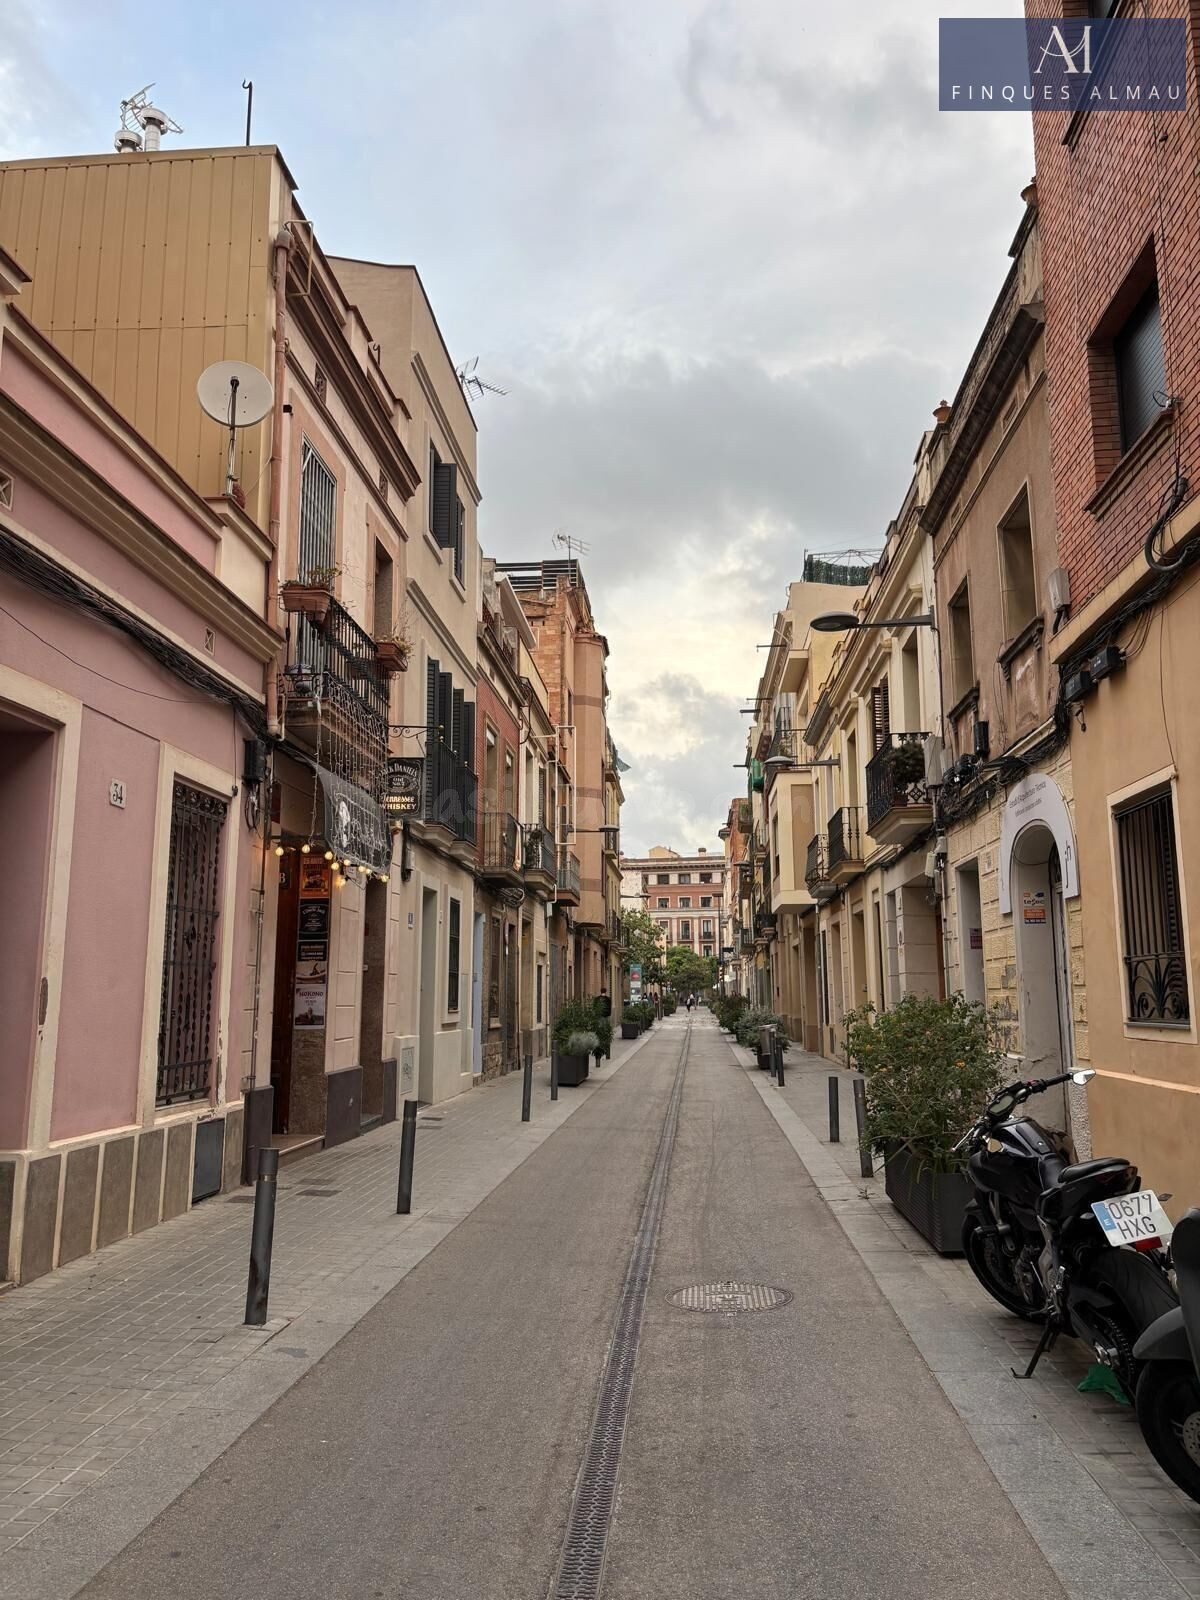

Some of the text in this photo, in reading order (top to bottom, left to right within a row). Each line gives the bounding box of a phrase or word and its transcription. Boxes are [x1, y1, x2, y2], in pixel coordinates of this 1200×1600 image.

[113, 783, 123, 804] 34
[1108, 1194, 1152, 1220] 0677
[1117, 1216, 1156, 1239] HXG
